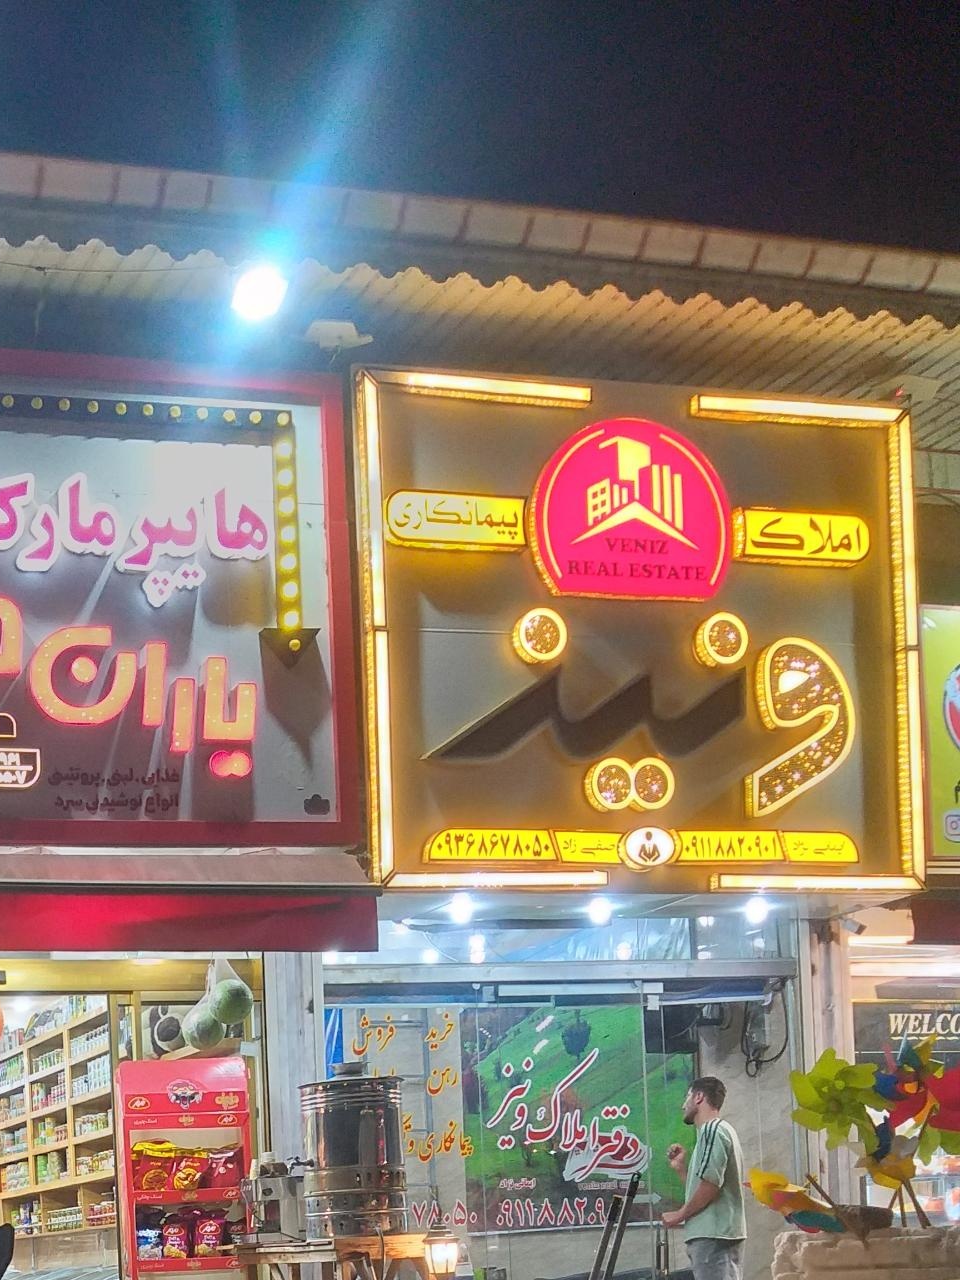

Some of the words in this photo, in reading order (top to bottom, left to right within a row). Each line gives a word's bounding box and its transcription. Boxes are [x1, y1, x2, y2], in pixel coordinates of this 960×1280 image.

[393, 499, 519, 540] پیمانکاری
[751, 516, 861, 555] املاک
[116, 487, 270, 607] هایپر
[605, 537, 669, 556] VENIZ
[567, 560, 623, 578] REAL
[629, 562, 707, 581] ESTATE
[420, 608, 855, 818] ونیز
[437, 833, 551, 857] ۰۹۳۶۸۶۷۸۰۵۰
[684, 835, 777, 858] ۰۹۱۱۸۸۲۰۹۰۱
[352, 1016, 396, 1056] فروش
[426, 1013, 454, 1049] خرید
[427, 1067, 458, 1096] رهن
[527, 1047, 599, 1151] املاک
[487, 1057, 534, 1150] ونیز
[576, 1104, 640, 1182] دفتر
